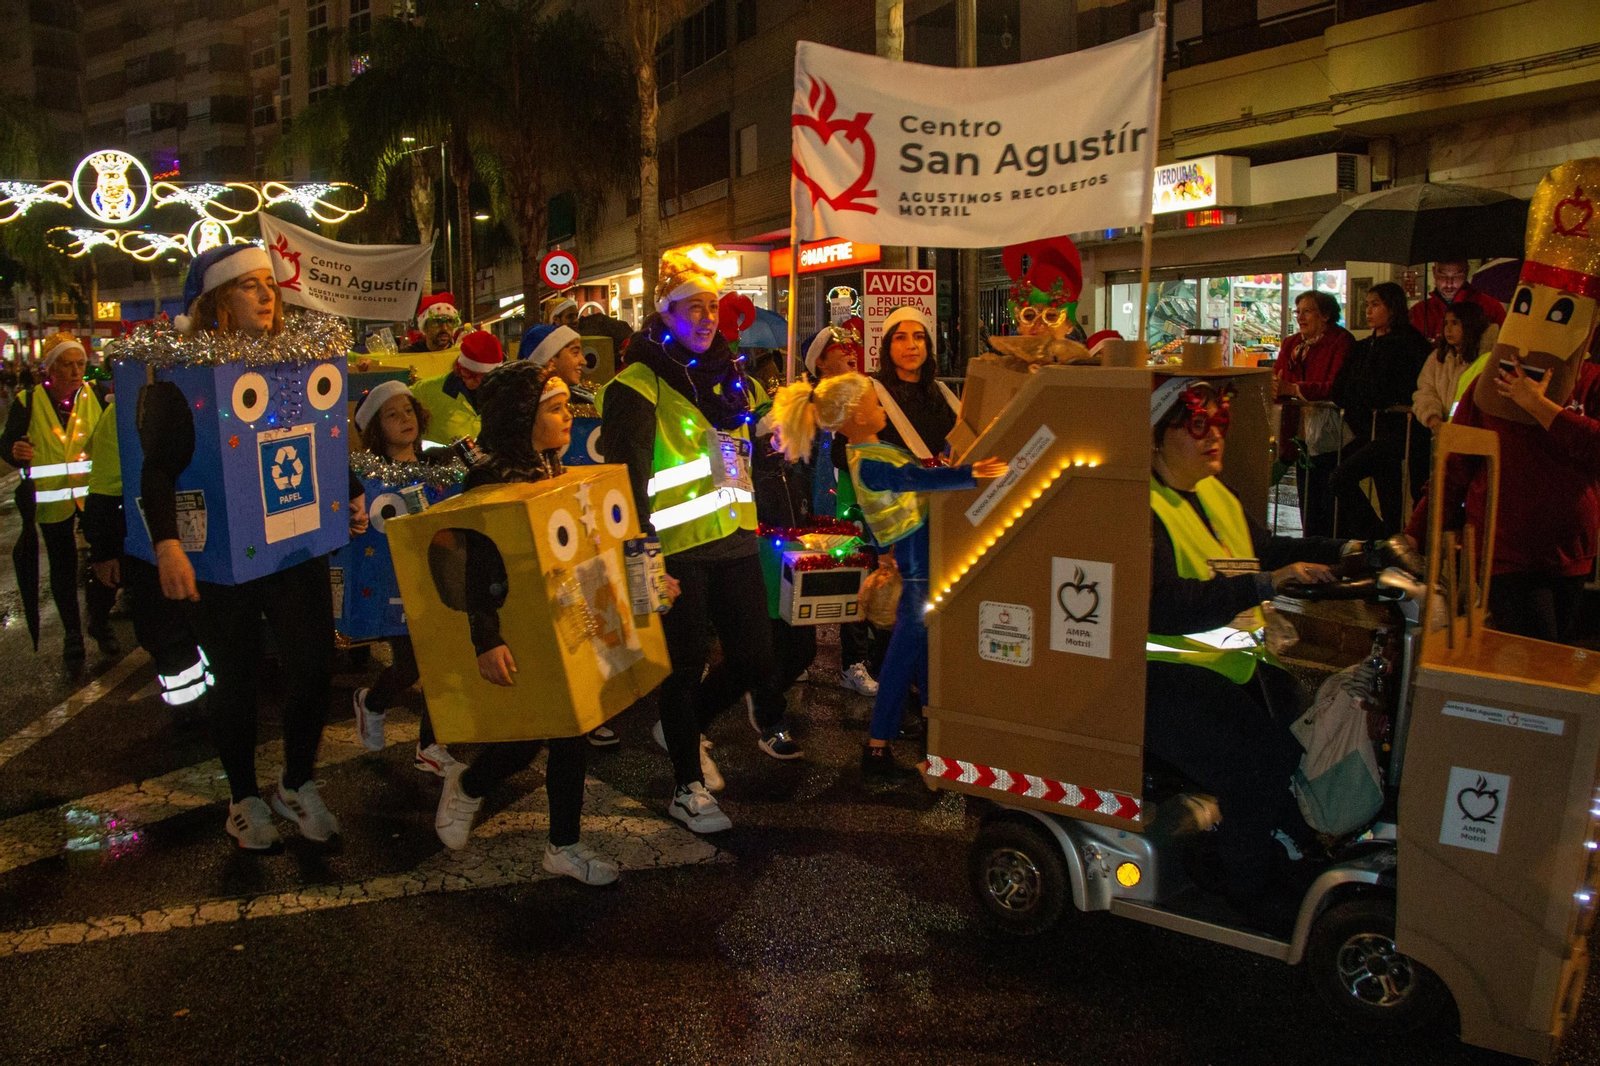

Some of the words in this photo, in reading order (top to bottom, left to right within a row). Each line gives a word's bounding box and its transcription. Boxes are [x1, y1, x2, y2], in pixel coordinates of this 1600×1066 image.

[899, 115, 1002, 138] Centro
[899, 142, 980, 176] San
[1157, 163, 1198, 186] VERDURAS
[899, 191, 1003, 204] AGUSTINOS
[1011, 173, 1109, 201] RECOLETOS
[899, 205, 971, 217] MOTRIL
[807, 242, 853, 265] MAPFRE
[311, 256, 352, 272] Centro
[550, 263, 570, 276] 30
[308, 268, 341, 286] San
[347, 277, 418, 293] Agustín
[868, 274, 932, 293] AVISO
[308, 287, 350, 300] AGUSTINOS
[353, 295, 398, 303] RECOLETOS
[876, 296, 924, 307] PRUEBA
[868, 306, 933, 316] DEPVA
[279, 492, 302, 505] PAPEL
[1066, 628, 1091, 638] AMPA
[1065, 637, 1091, 648] Motril
[1462, 824, 1487, 835] AMPA
[1461, 833, 1486, 843] Motril
